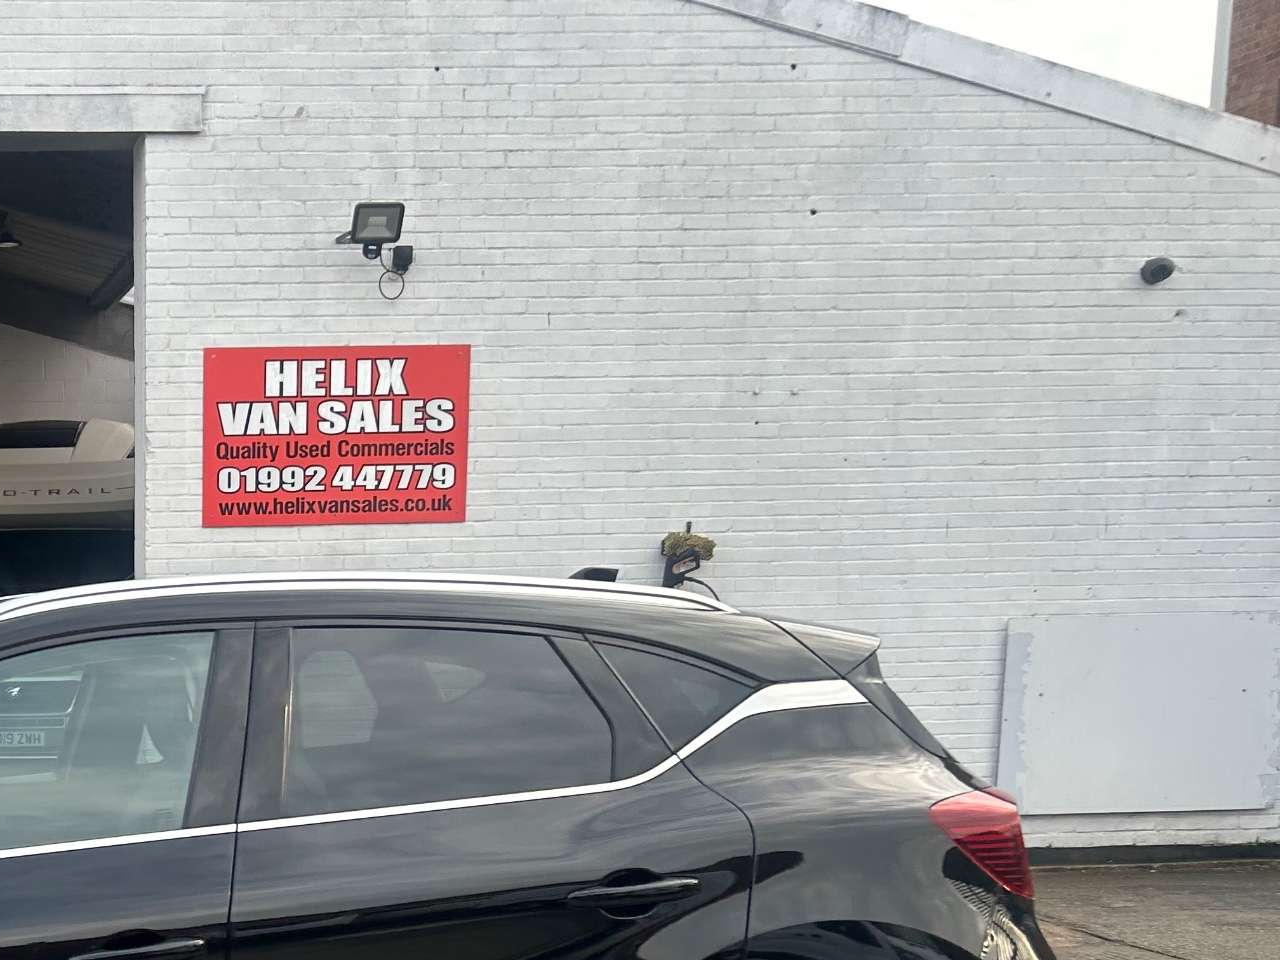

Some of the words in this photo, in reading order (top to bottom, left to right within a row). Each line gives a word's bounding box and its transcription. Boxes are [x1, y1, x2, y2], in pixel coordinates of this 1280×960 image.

[264, 358, 409, 398] HELIX
[217, 400, 308, 436] VAN
[317, 397, 455, 435] SALES
[216, 441, 280, 462] Quality
[286, 441, 331, 459] Used
[337, 439, 455, 457] Commercials
[217, 465, 327, 494] 01992
[331, 463, 456, 492] 447779
[219, 495, 453, 515] www.helixvansales.co.uk
